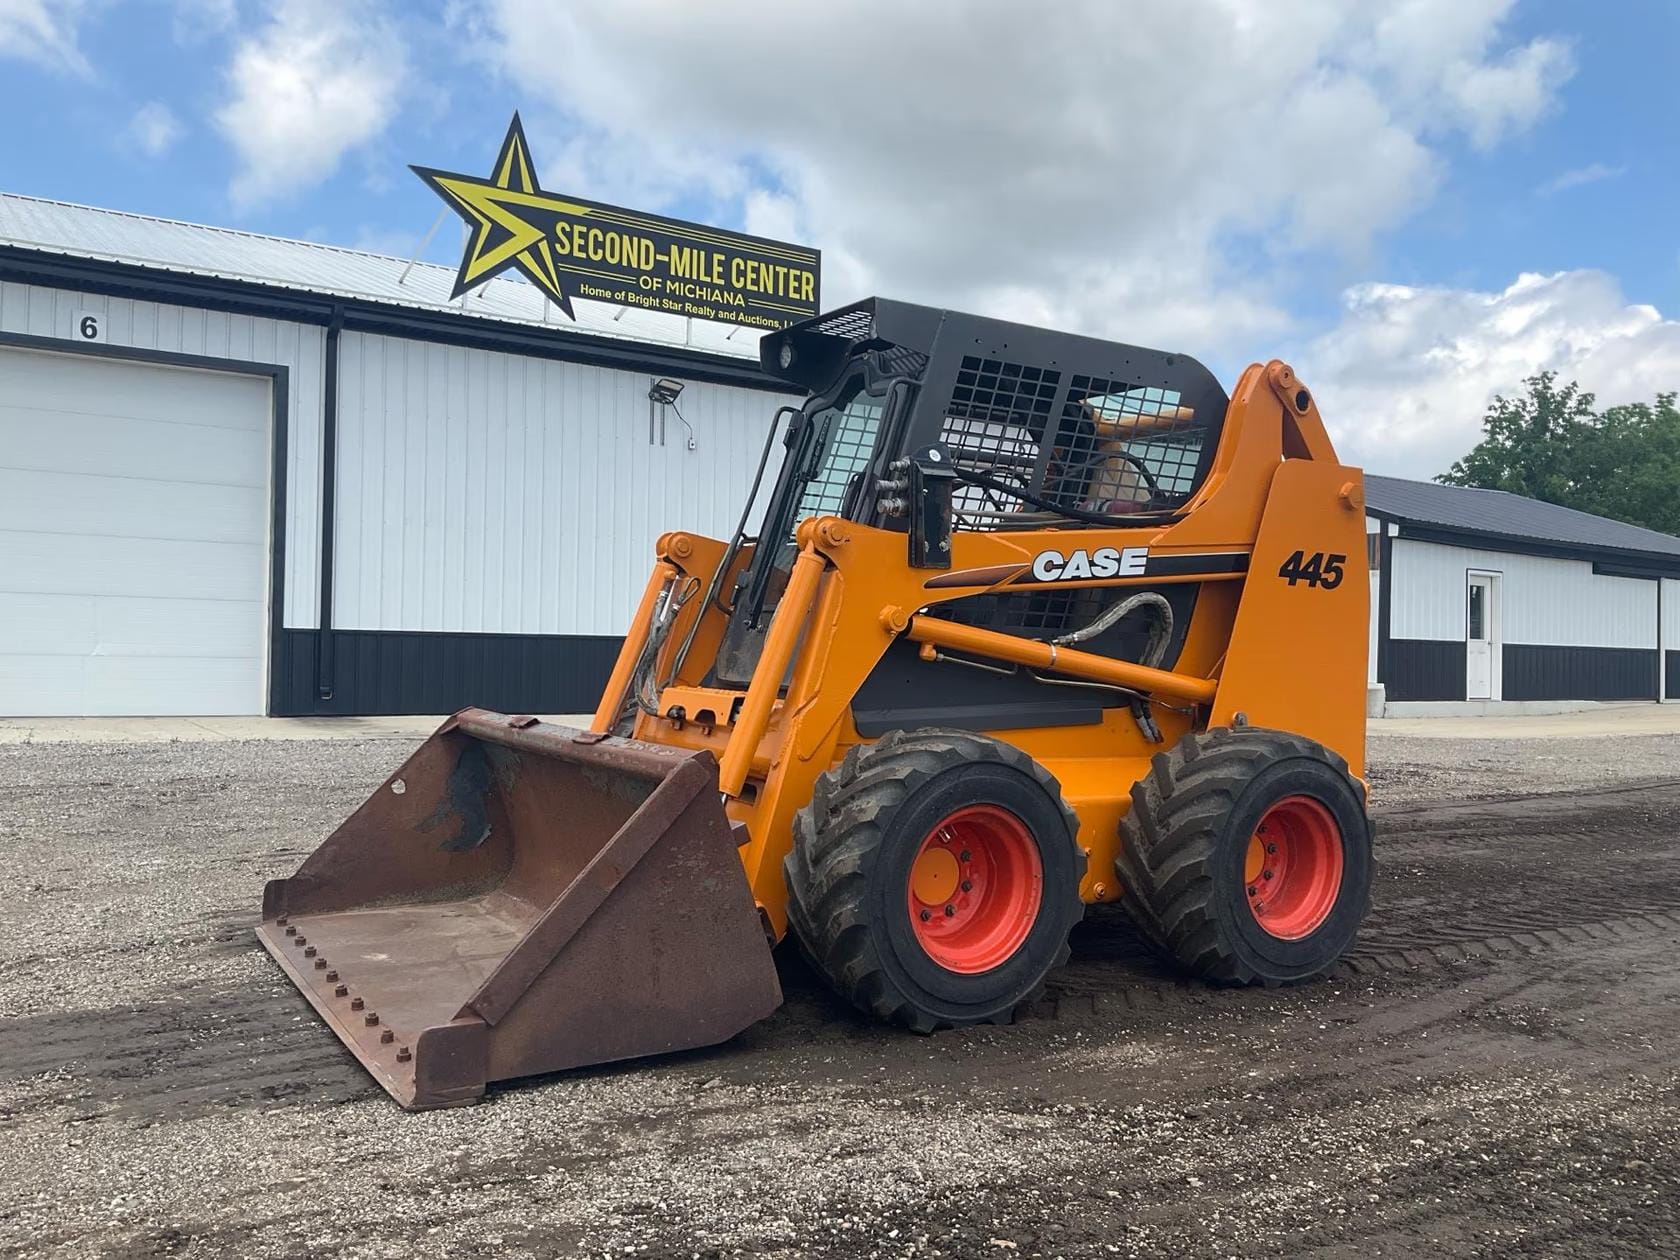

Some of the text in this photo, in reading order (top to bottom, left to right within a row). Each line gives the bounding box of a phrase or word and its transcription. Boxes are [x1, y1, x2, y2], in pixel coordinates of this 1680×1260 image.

[554, 221, 815, 302] SECOND-MILE CENTER
[580, 284, 611, 299] Home
[614, 290, 625, 301] of
[628, 292, 660, 309] Bright
[662, 298, 683, 312] Star
[685, 302, 716, 319] Realty
[718, 308, 736, 320] and
[738, 312, 782, 330] Auctions,
[639, 276, 745, 307] OF MICHIANA
[80, 316, 98, 340] 6
[1031, 546, 1149, 582] CASE
[1278, 549, 1347, 590] 445
